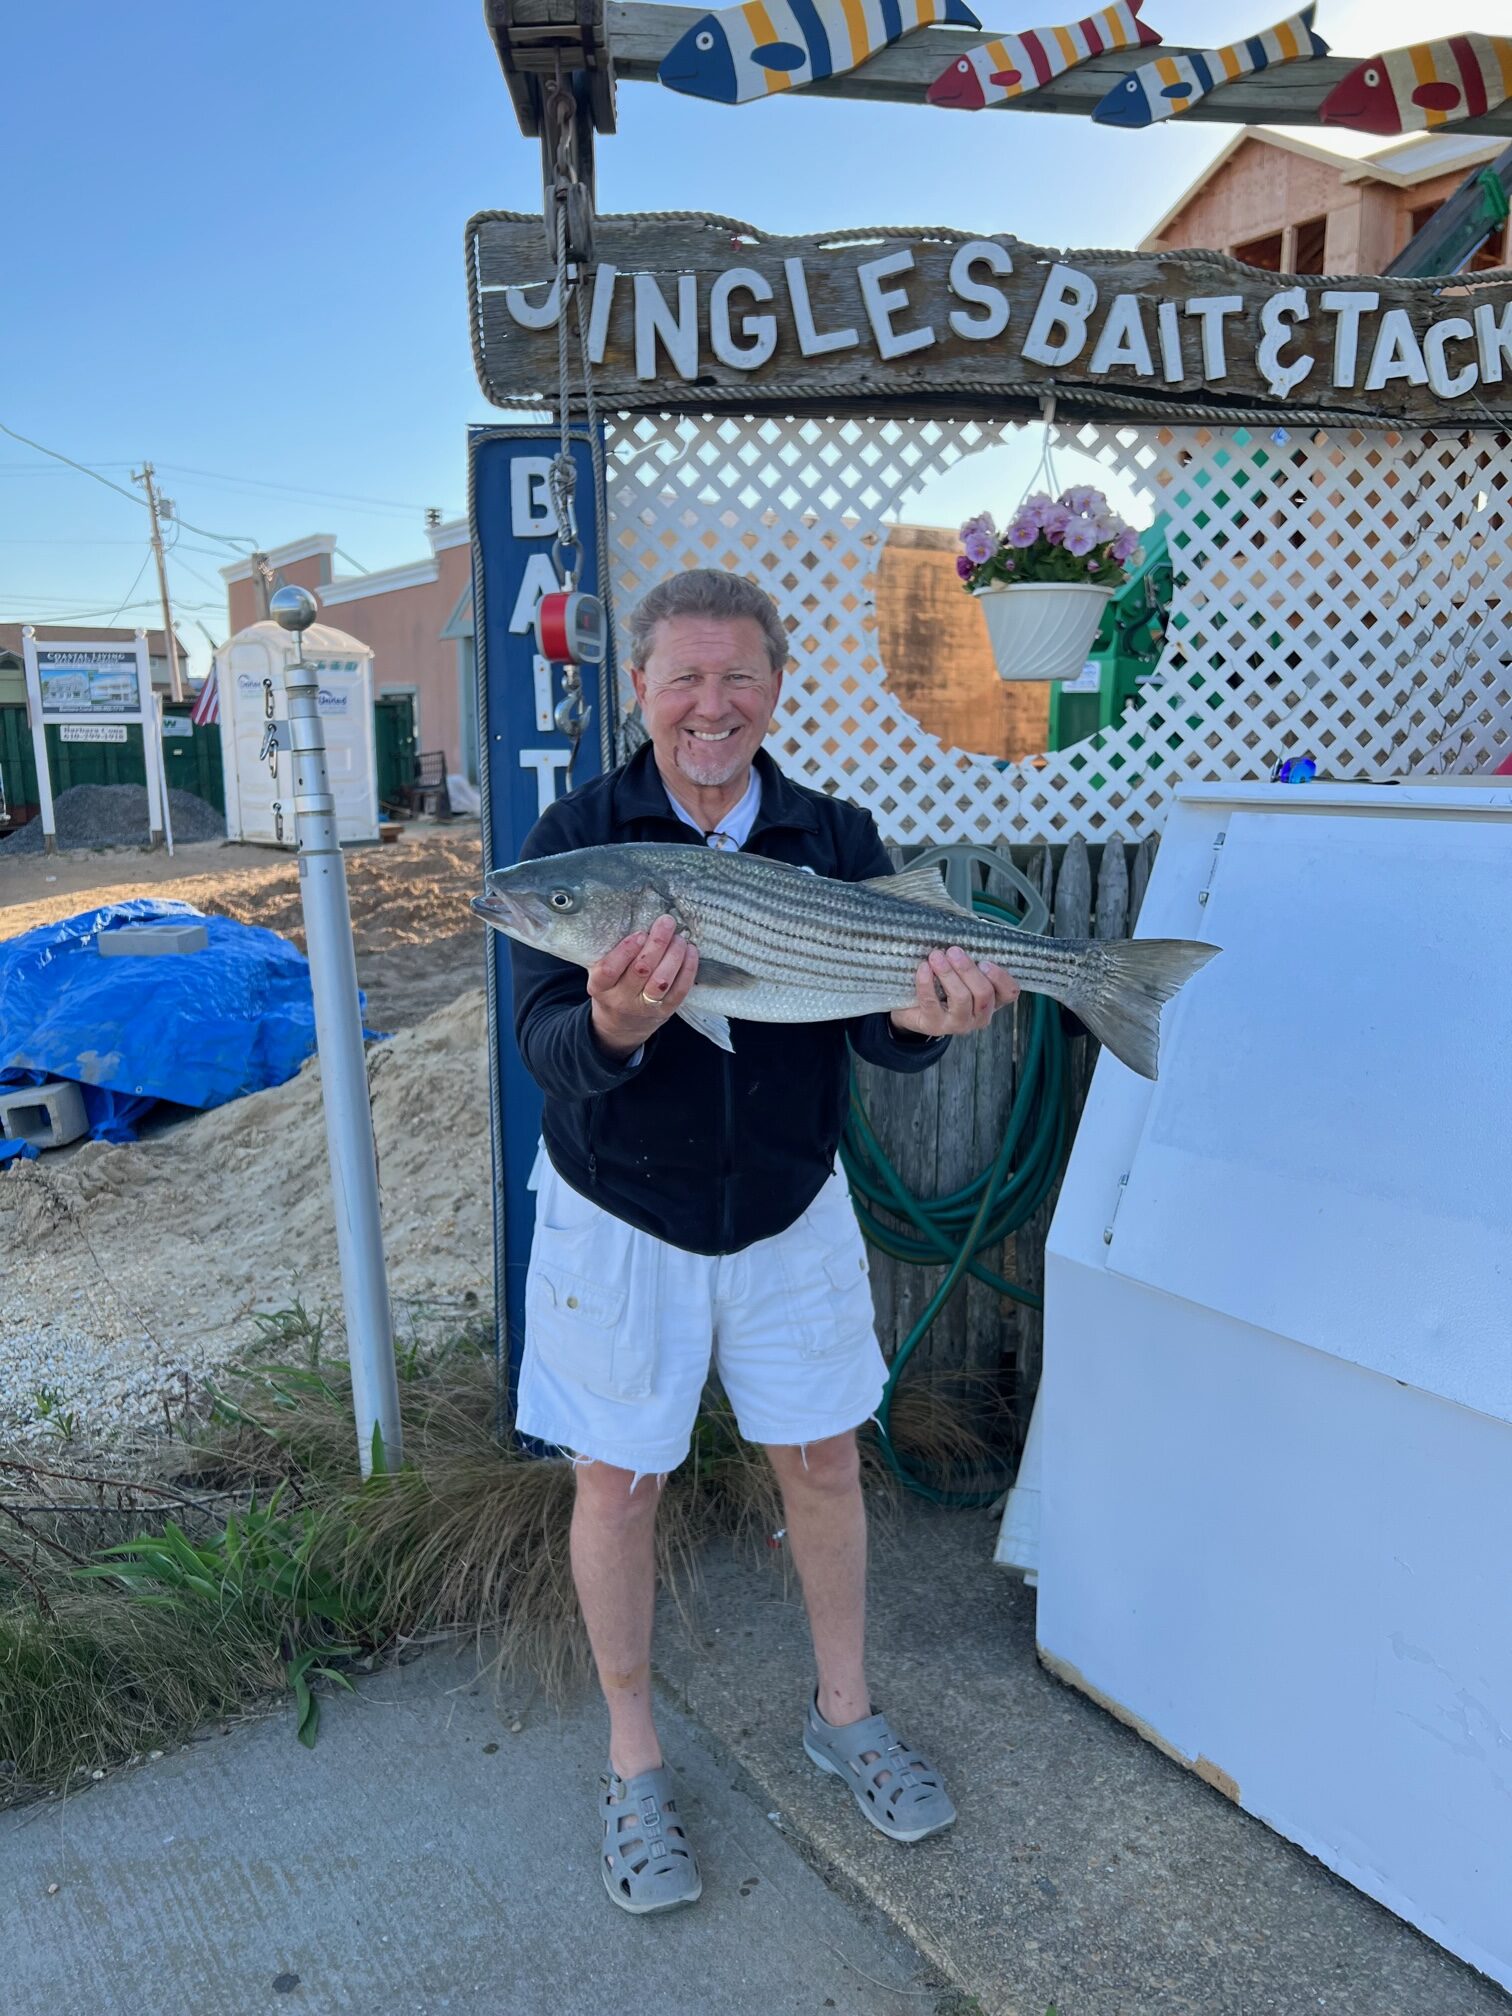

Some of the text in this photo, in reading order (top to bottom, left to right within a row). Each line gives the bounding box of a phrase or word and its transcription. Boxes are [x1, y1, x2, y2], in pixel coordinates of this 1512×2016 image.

[506, 241, 1512, 400] JINGLES BAIT & TACK
[508, 456, 572, 818] BAIT
